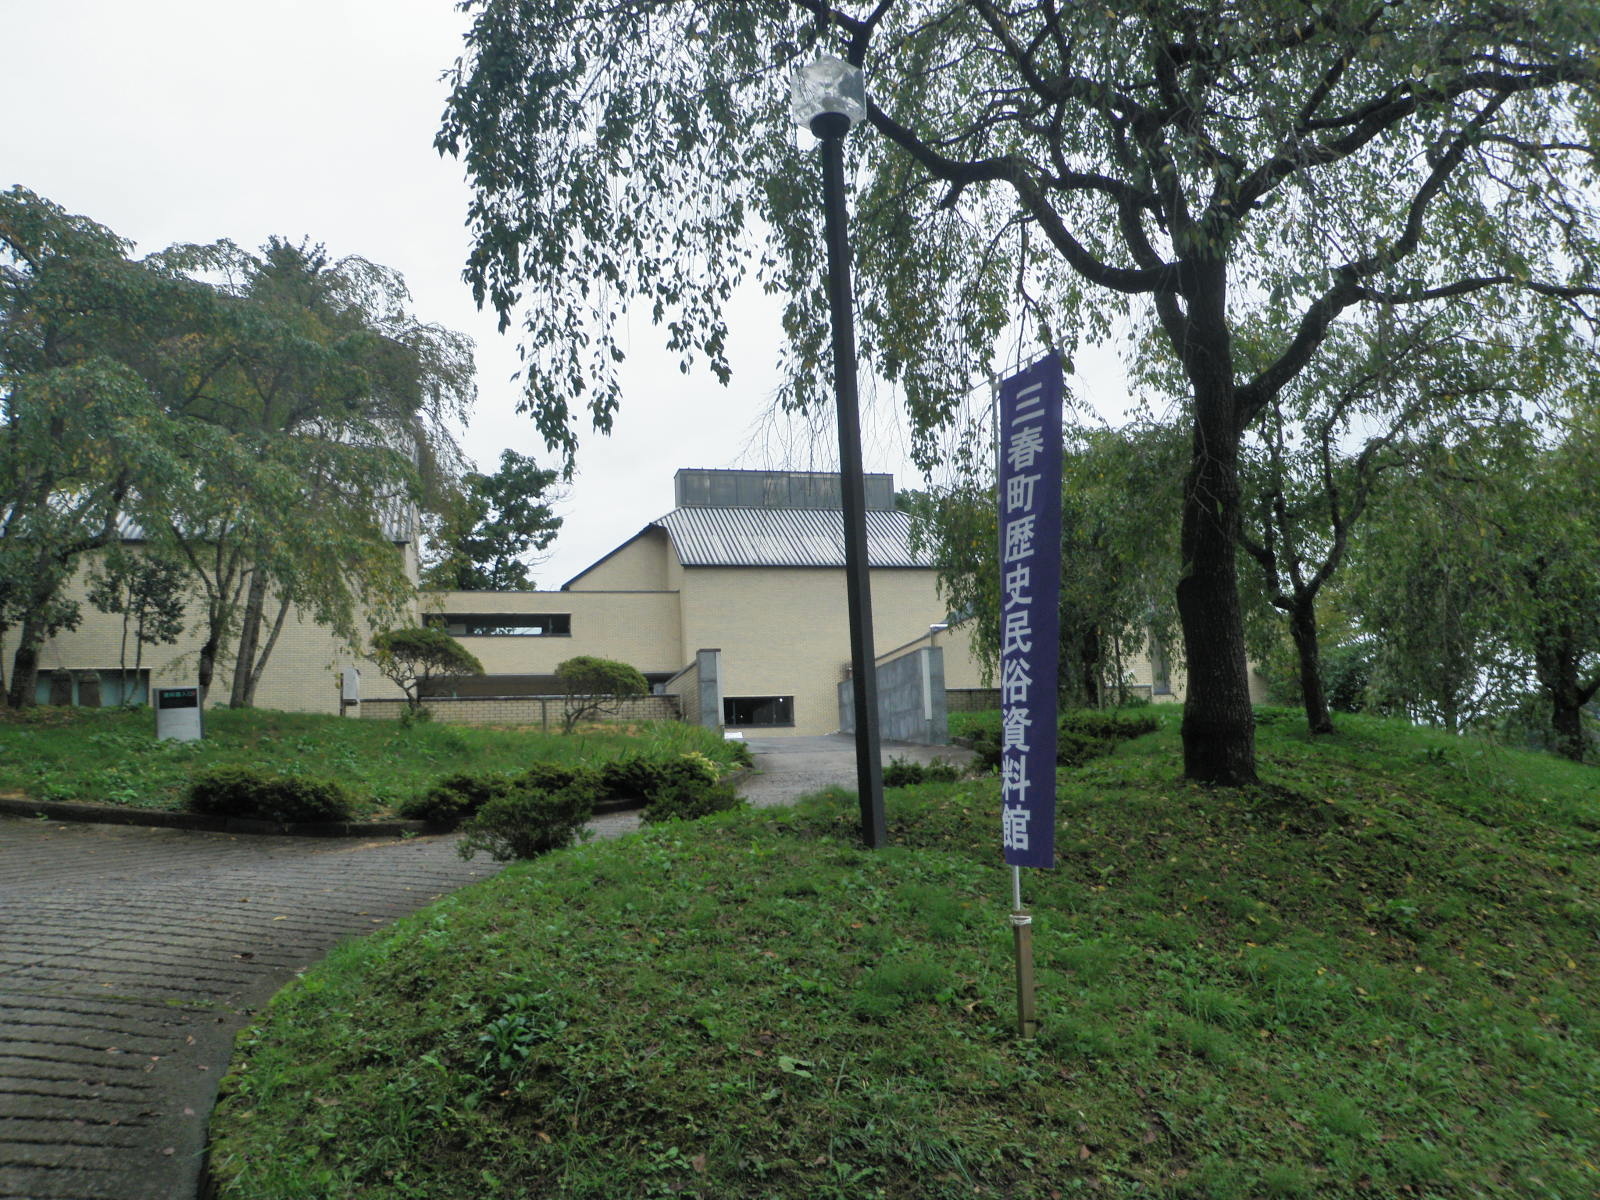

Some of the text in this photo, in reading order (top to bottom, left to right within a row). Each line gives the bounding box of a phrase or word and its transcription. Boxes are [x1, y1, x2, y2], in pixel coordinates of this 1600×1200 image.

[1002, 382, 1045, 850] 三春町歴史民俗資料館
